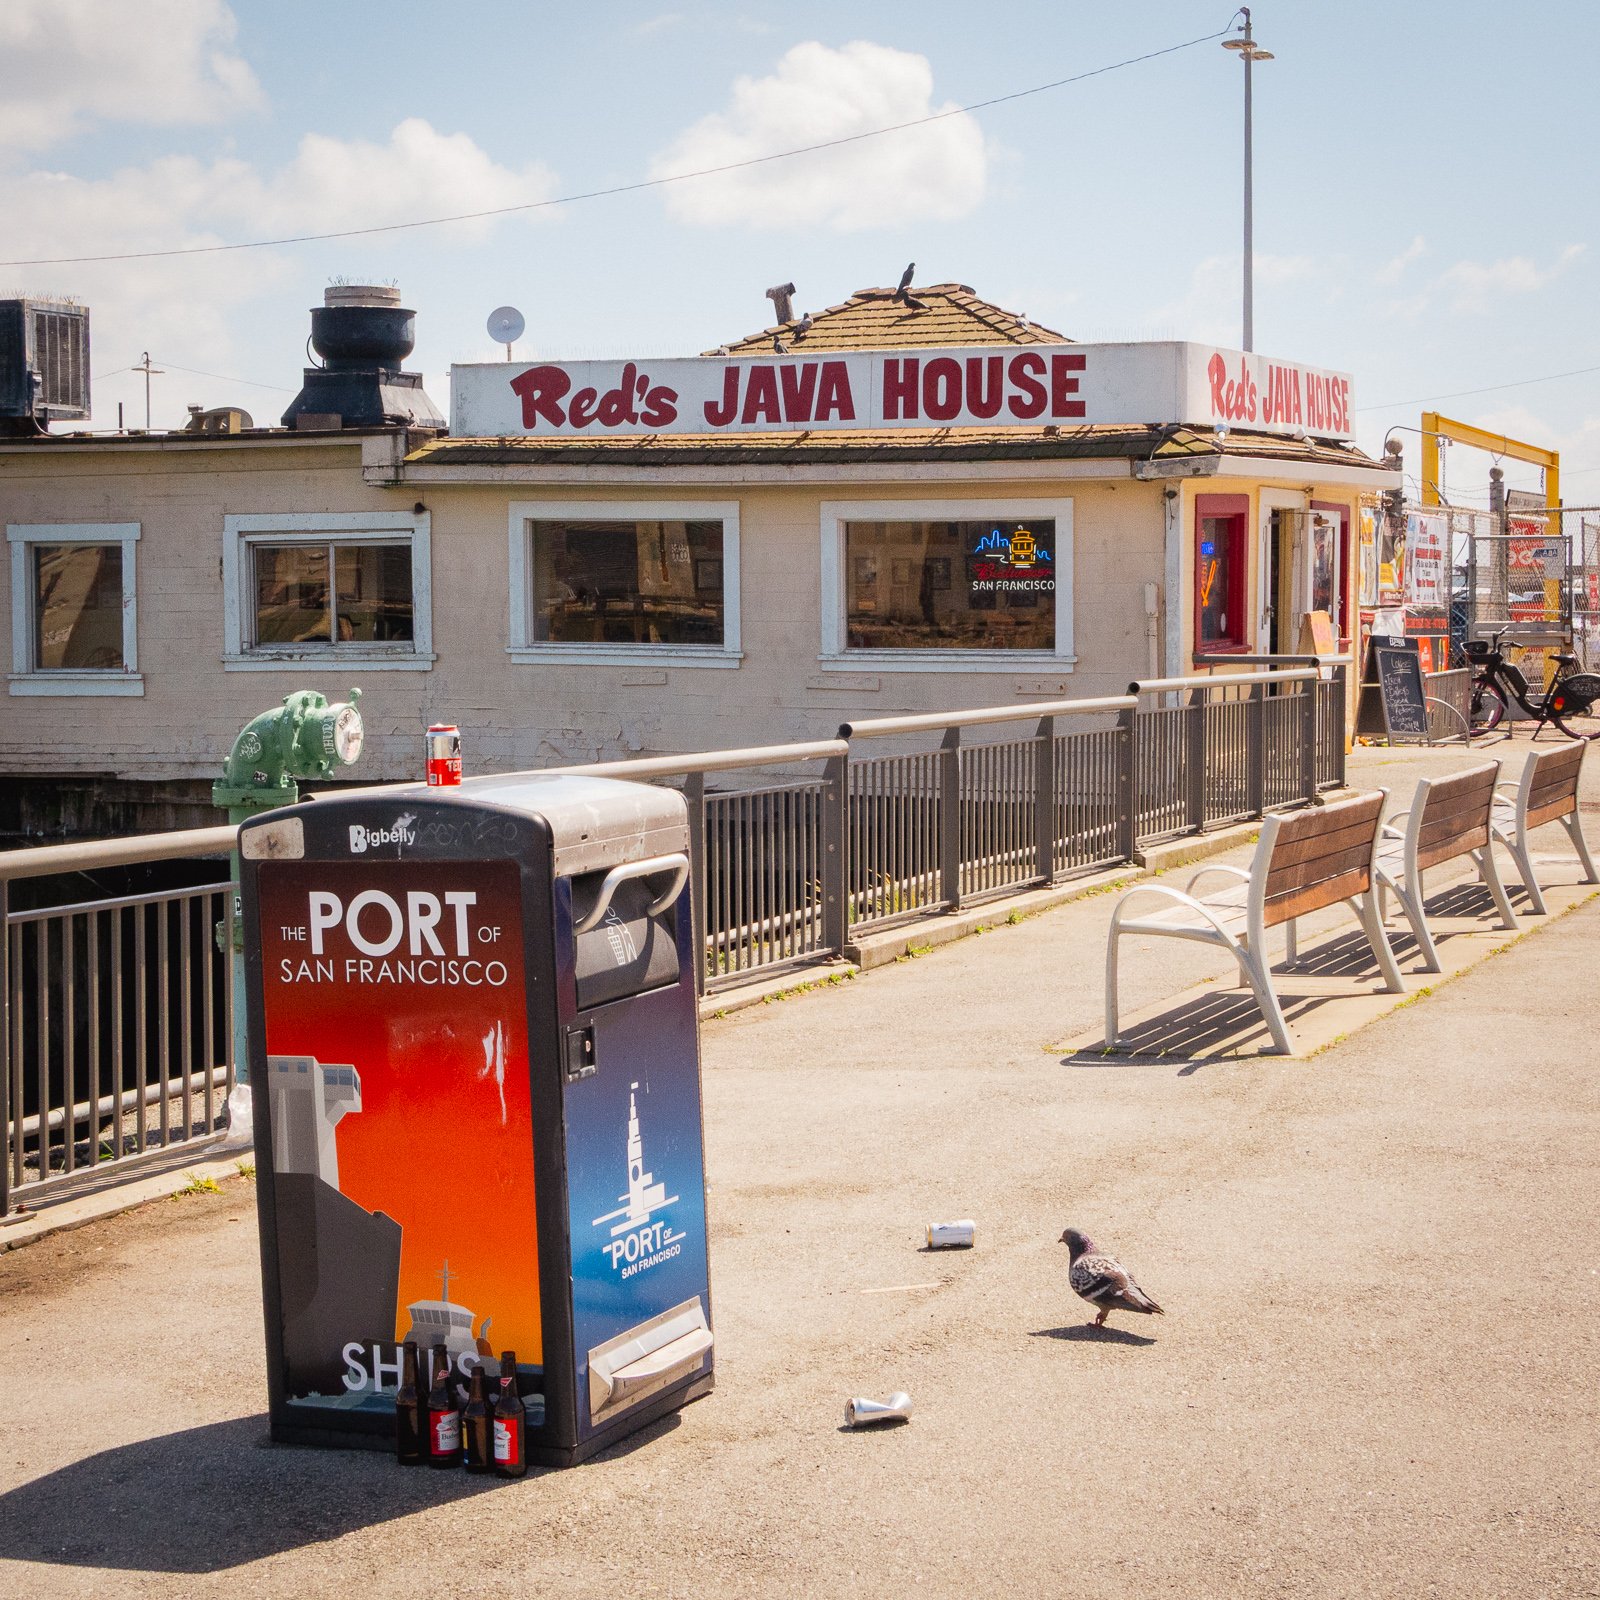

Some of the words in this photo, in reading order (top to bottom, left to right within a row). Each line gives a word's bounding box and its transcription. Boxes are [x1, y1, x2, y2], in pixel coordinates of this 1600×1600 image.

[510, 362, 678, 429] Red's
[705, 361, 856, 426] JAVA
[883, 353, 1086, 419] HOUSE
[1207, 352, 1257, 423] Red's
[1262, 364, 1303, 425] JAVA
[1306, 372, 1350, 433] HOUSE
[972, 580, 994, 591] SAN
[996, 580, 1055, 591] FRANCISCO
[348, 824, 416, 853] Bigbelly
[280, 926, 307, 941] THE
[308, 889, 477, 957] PORT
[477, 926, 501, 943] OF
[280, 958, 334, 983] SAN
[346, 959, 508, 986] FRANCISCO
[611, 1221, 665, 1270] PORT
[663, 1228, 672, 1240] OF
[621, 1263, 638, 1280] SAN
[638, 1244, 681, 1273] FRANCISCO
